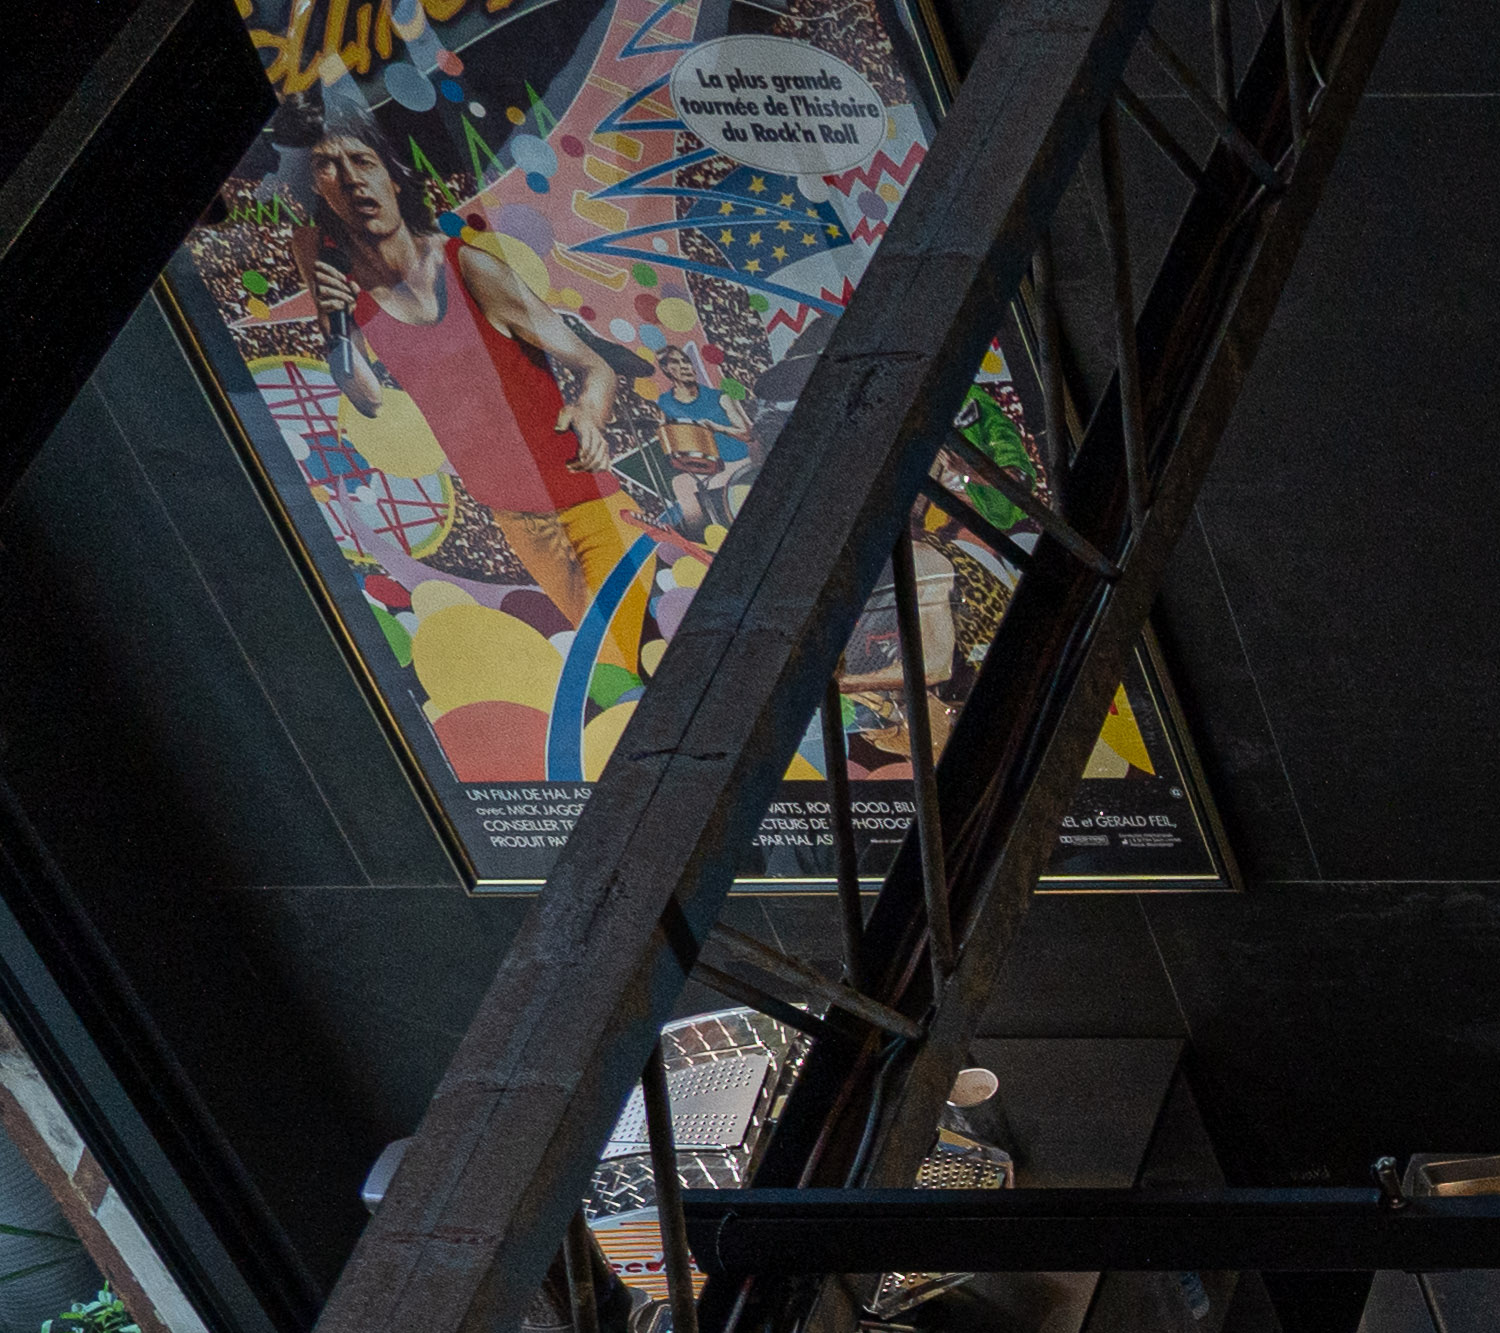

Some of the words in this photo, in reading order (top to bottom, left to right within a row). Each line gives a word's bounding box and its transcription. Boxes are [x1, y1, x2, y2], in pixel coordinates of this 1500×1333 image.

[696, 69, 721, 88] La
[725, 68, 767, 92] plus
[772, 70, 842, 93] grande
[681, 96, 759, 116] tournée
[764, 96, 788, 116] de
[792, 96, 880, 118] l'histoire
[722, 121, 749, 142] du
[751, 122, 816, 144] Rock'n
[818, 124, 858, 144] Roll
[465, 789, 489, 800] UN
[491, 788, 521, 800] FILM
[522, 788, 542, 800] DE
[542, 788, 571, 800] HAL
[476, 807, 506, 816] avec
[506, 804, 541, 816] MICK
[483, 820, 558, 831] CONSEILLER
[810, 818, 830, 830] DE
[1062, 816, 1079, 828] EL
[1095, 815, 1147, 828] GERALD
[490, 836, 545, 847] PRODUIT
[760, 834, 785, 846] PAR
[785, 834, 813, 846] HAL
